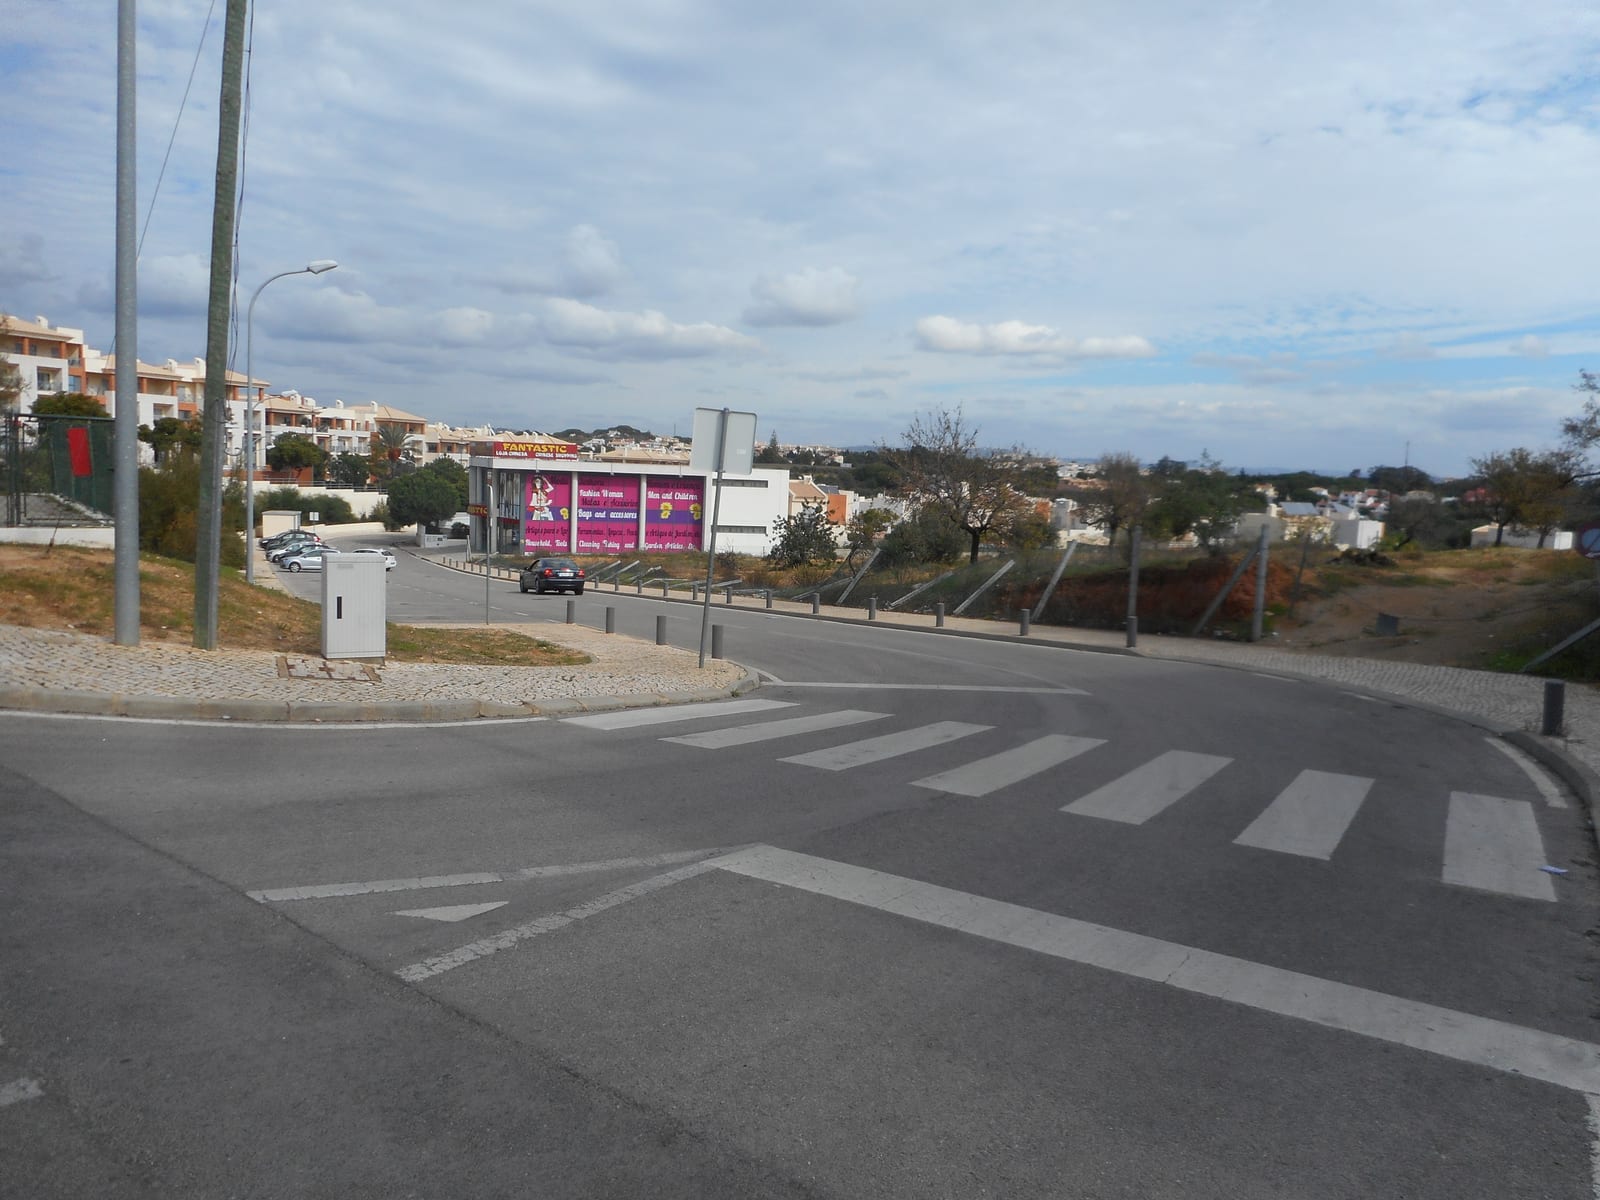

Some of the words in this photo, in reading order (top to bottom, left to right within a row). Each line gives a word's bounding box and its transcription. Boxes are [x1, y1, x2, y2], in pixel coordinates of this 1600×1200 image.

[502, 442, 568, 453] FANTASTIC
[579, 489, 600, 497] Fashion
[647, 491, 660, 499] Men
[661, 492, 672, 500] and
[674, 492, 698, 501] Children
[578, 509, 592, 520] Bags
[555, 539, 568, 547] Tools
[579, 540, 600, 549] Cleaning
[644, 542, 663, 551] Garden
